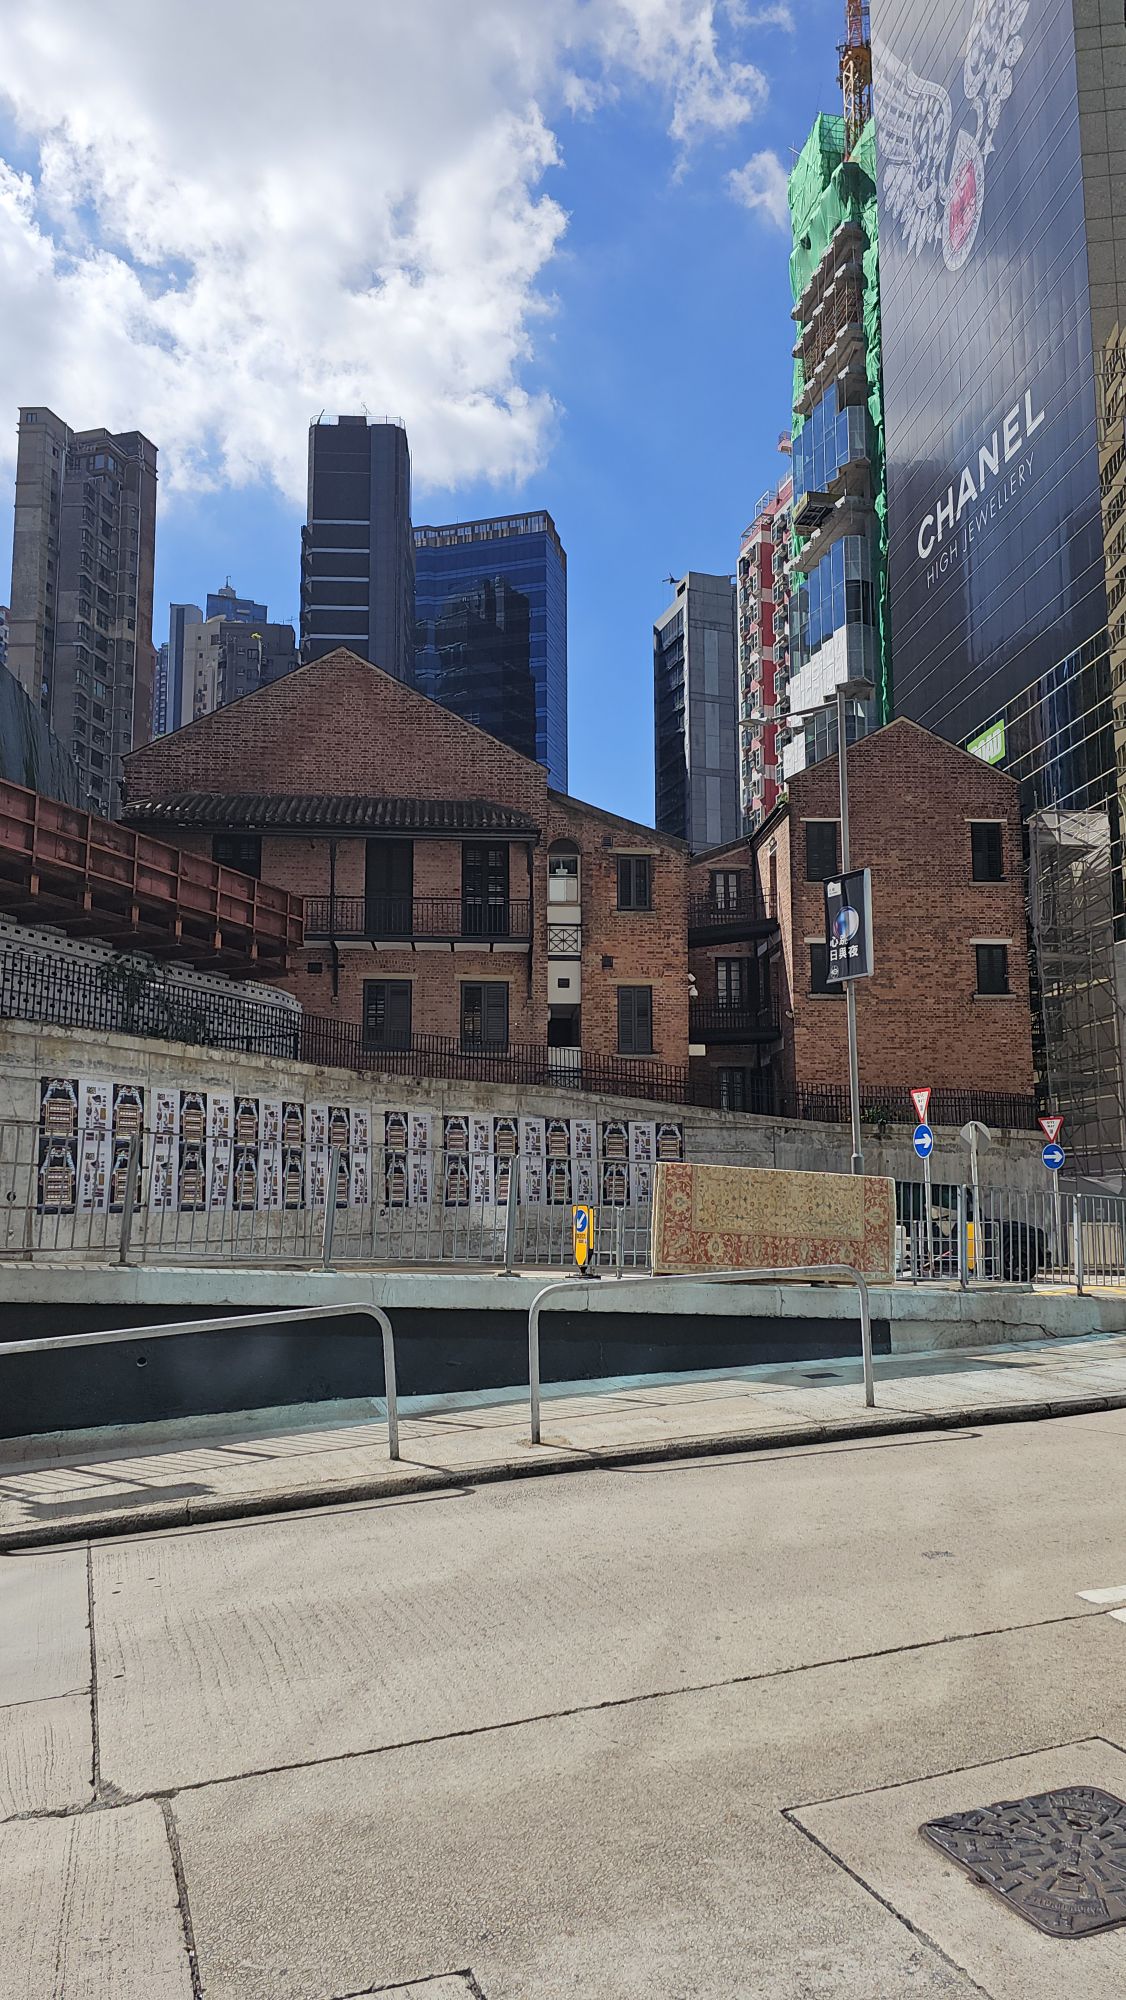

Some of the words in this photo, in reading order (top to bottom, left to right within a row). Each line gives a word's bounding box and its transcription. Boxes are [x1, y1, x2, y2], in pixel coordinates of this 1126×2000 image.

[917, 388, 1045, 559] CHANEL
[926, 539, 958, 589] HIGH
[963, 452, 1034, 553] JEWELLERY
[830, 944, 859, 961] 日與夜
